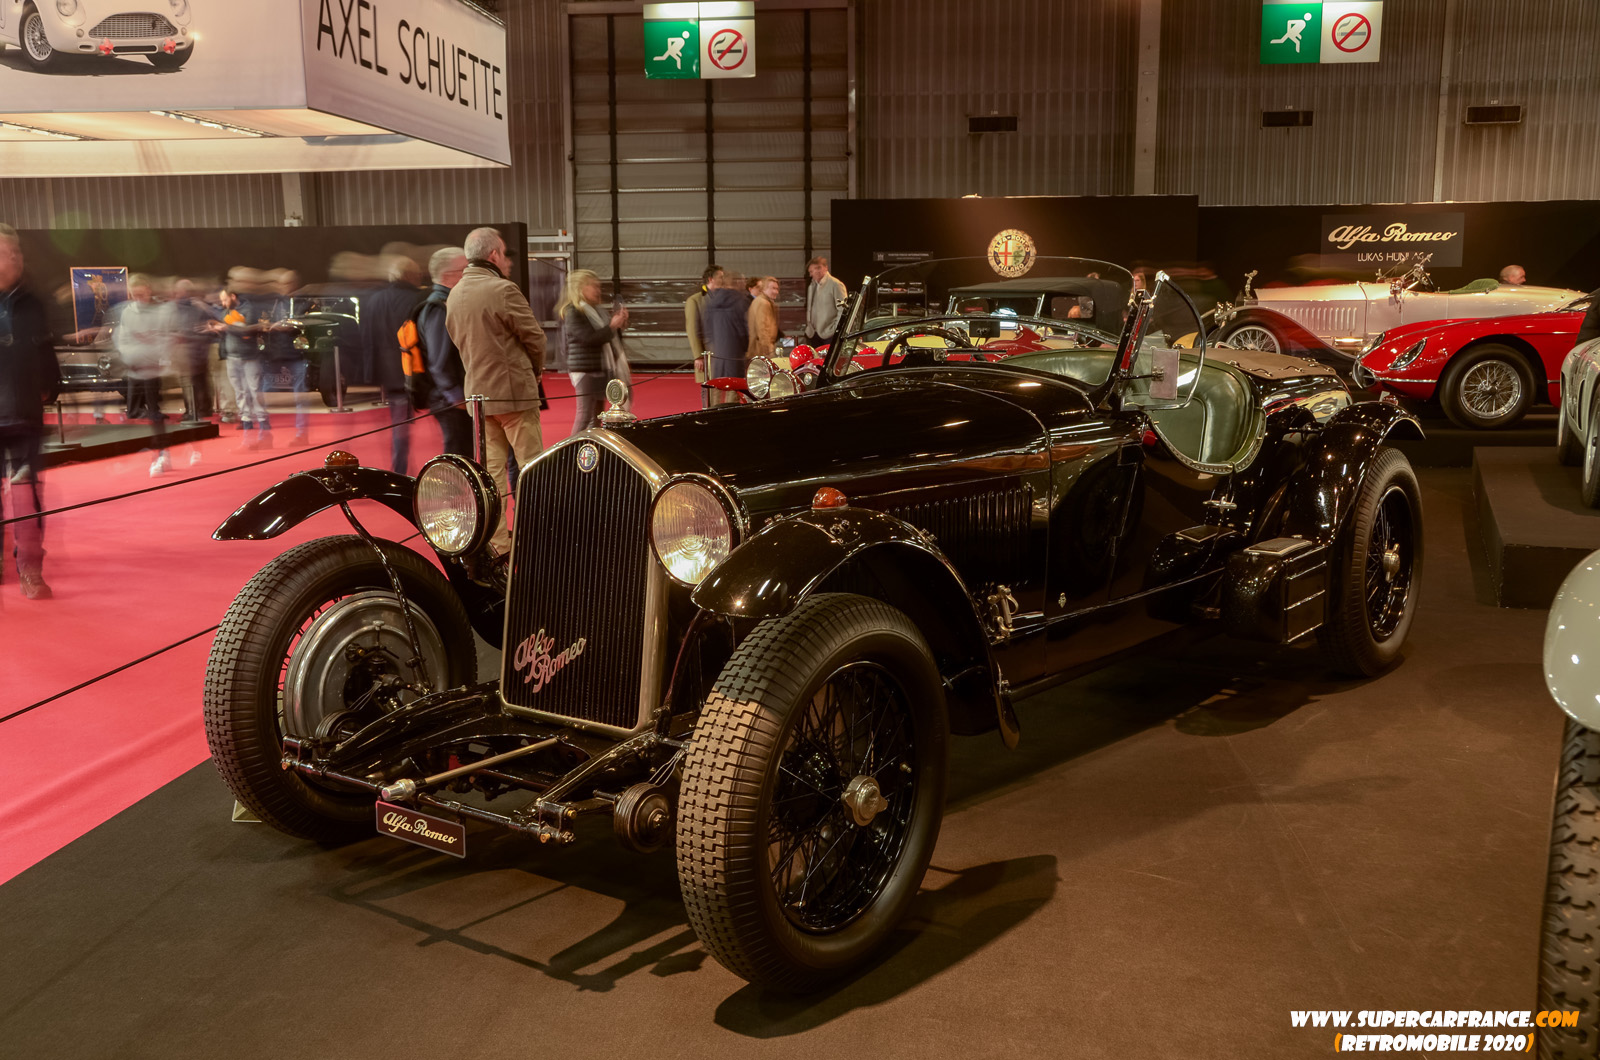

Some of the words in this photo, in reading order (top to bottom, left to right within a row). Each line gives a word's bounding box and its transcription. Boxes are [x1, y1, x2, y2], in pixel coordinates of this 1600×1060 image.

[317, 0, 388, 76] AXEL
[398, 19, 502, 120] SCHUETTE
[1328, 225, 1380, 250] Alfa
[1381, 222, 1457, 242] Romeo
[1357, 252, 1384, 262] LUKAS
[532, 637, 587, 693] Romeo
[383, 811, 413, 833] Alfa
[413, 818, 457, 844] Romeo
